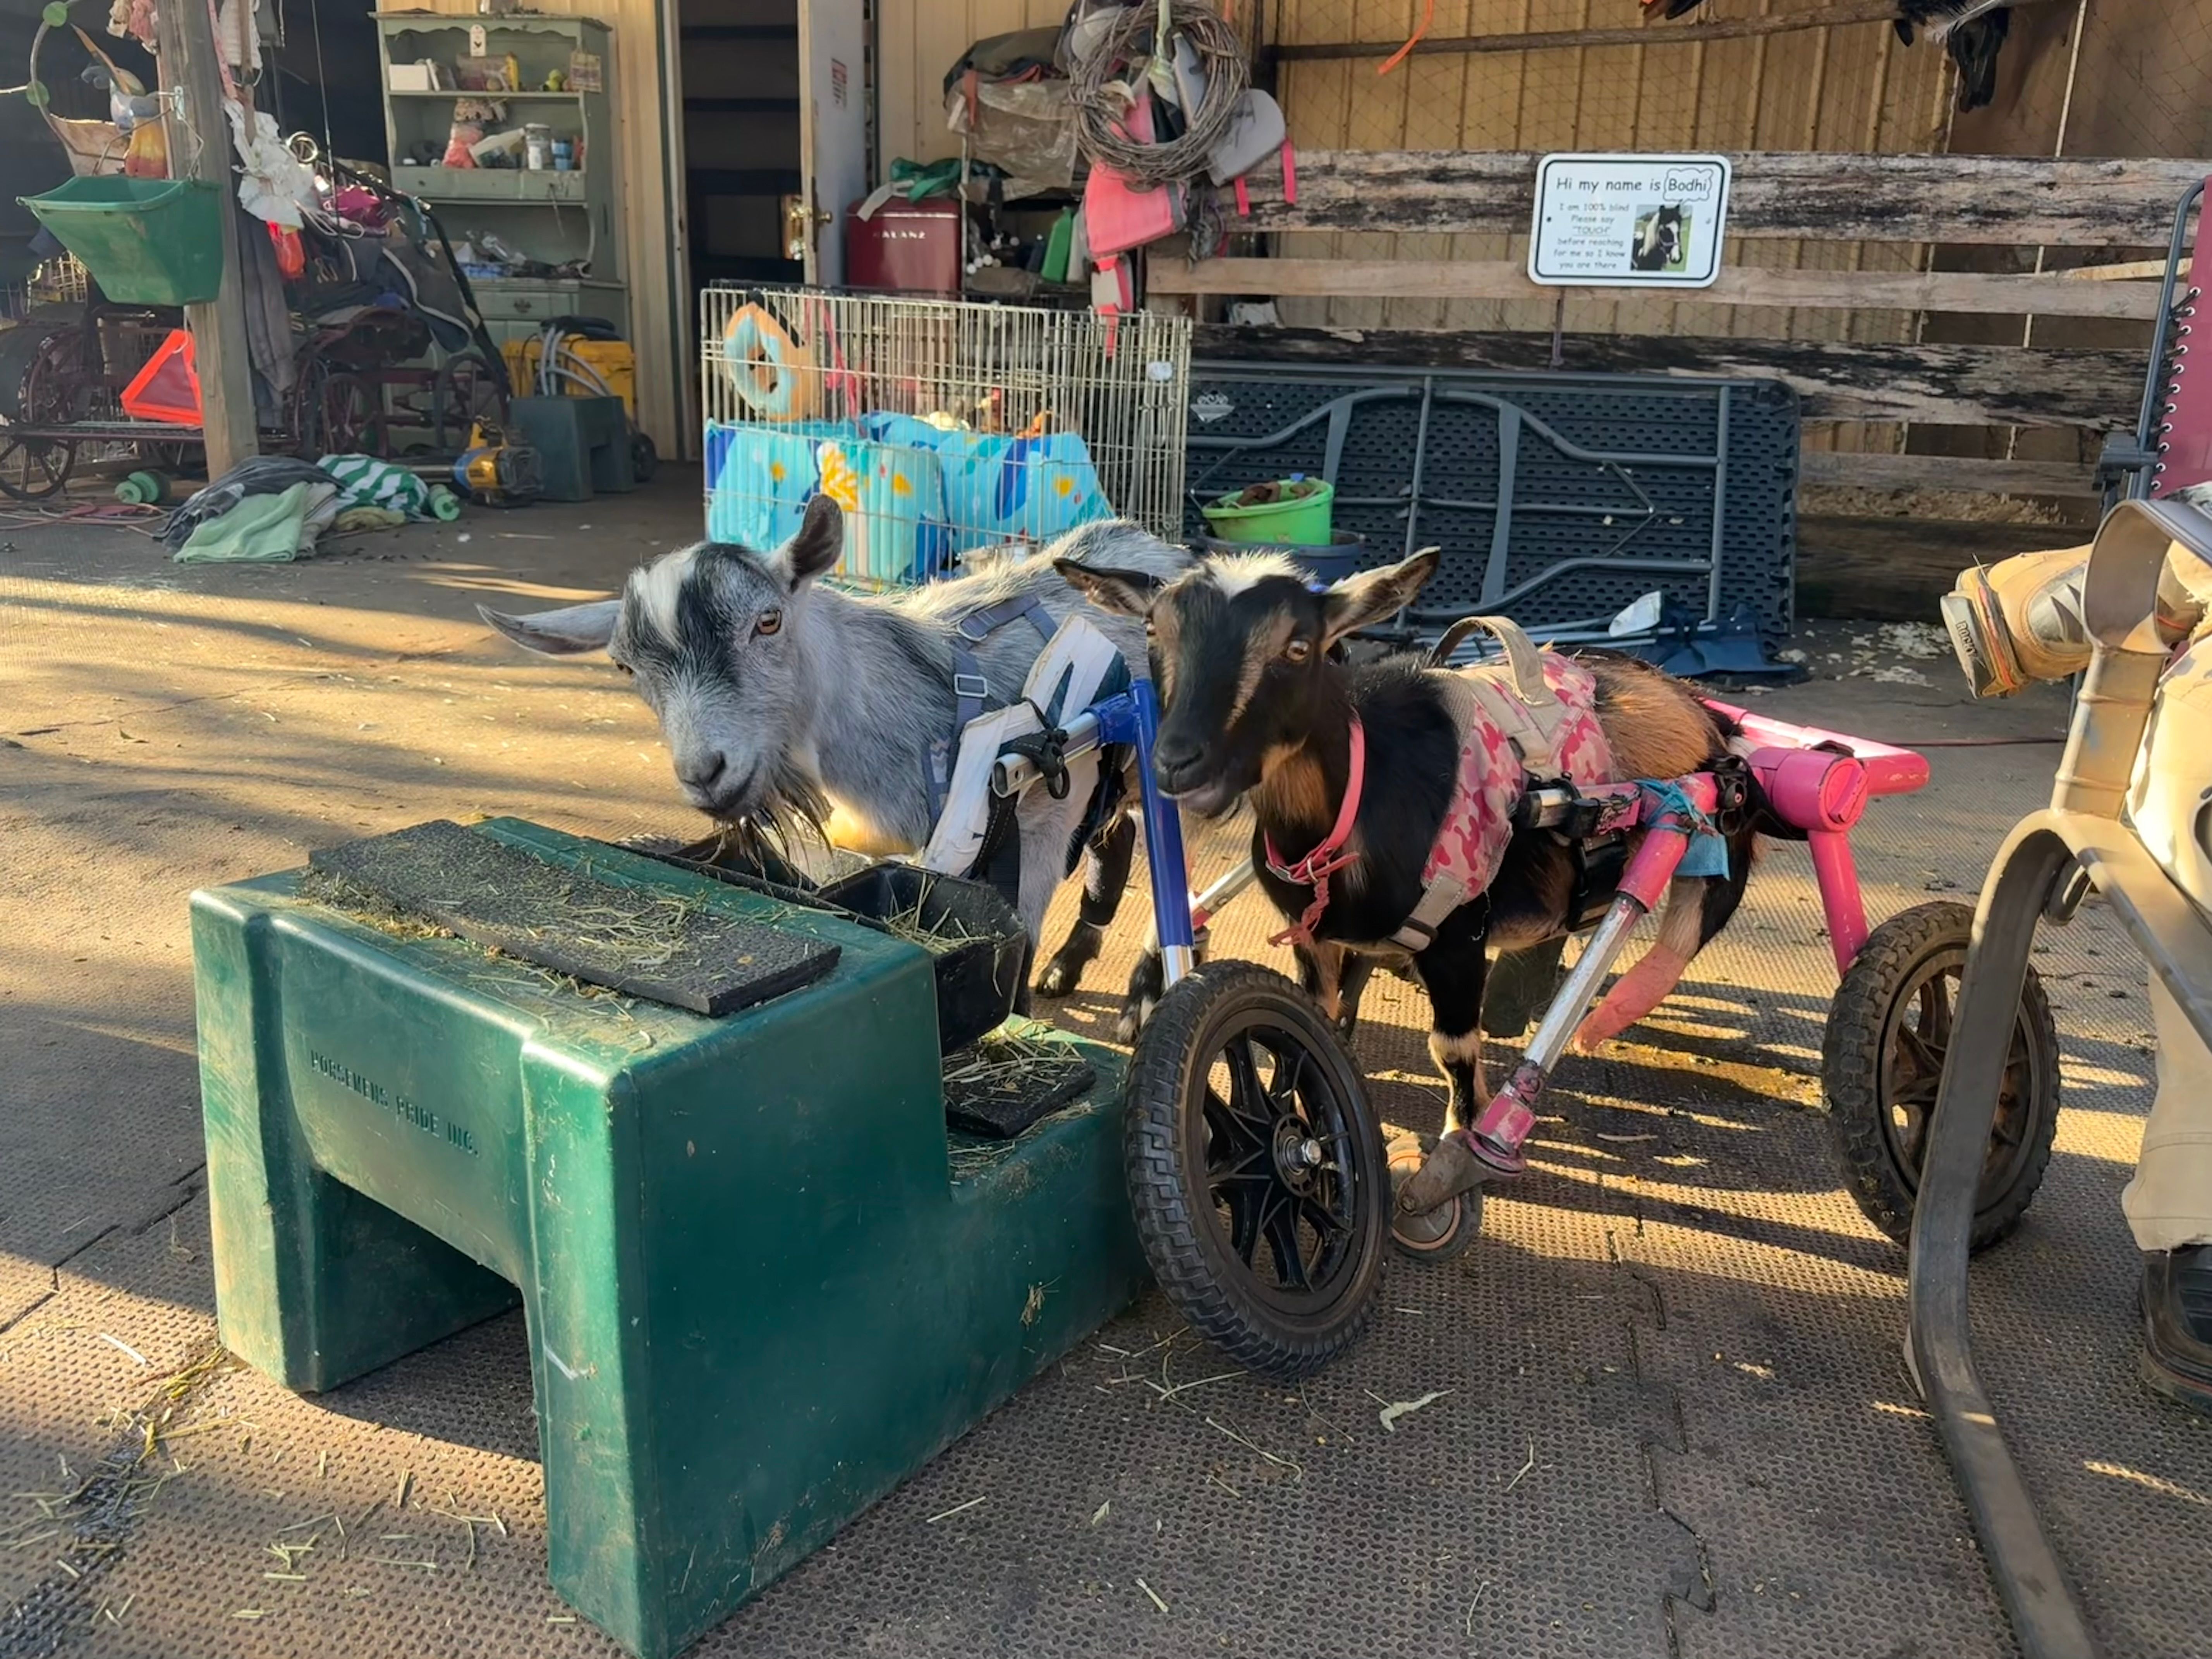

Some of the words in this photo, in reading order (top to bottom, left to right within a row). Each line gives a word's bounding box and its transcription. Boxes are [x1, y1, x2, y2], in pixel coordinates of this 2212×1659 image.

[1556, 177, 1572, 190] Hi
[1579, 181, 1599, 194] my
[1606, 181, 1642, 191] name
[1650, 179, 1661, 191] is
[1669, 178, 1707, 191] Bodhi
[1571, 215, 1596, 223] Please
[1589, 239, 1624, 249] reaching
[1554, 249, 1566, 257] for
[1955, 620, 1978, 657] ROCKY
[311, 1049, 388, 1109] HORSEMENS
[397, 1096, 439, 1138] PRIDE
[448, 1122, 479, 1158] INC.
